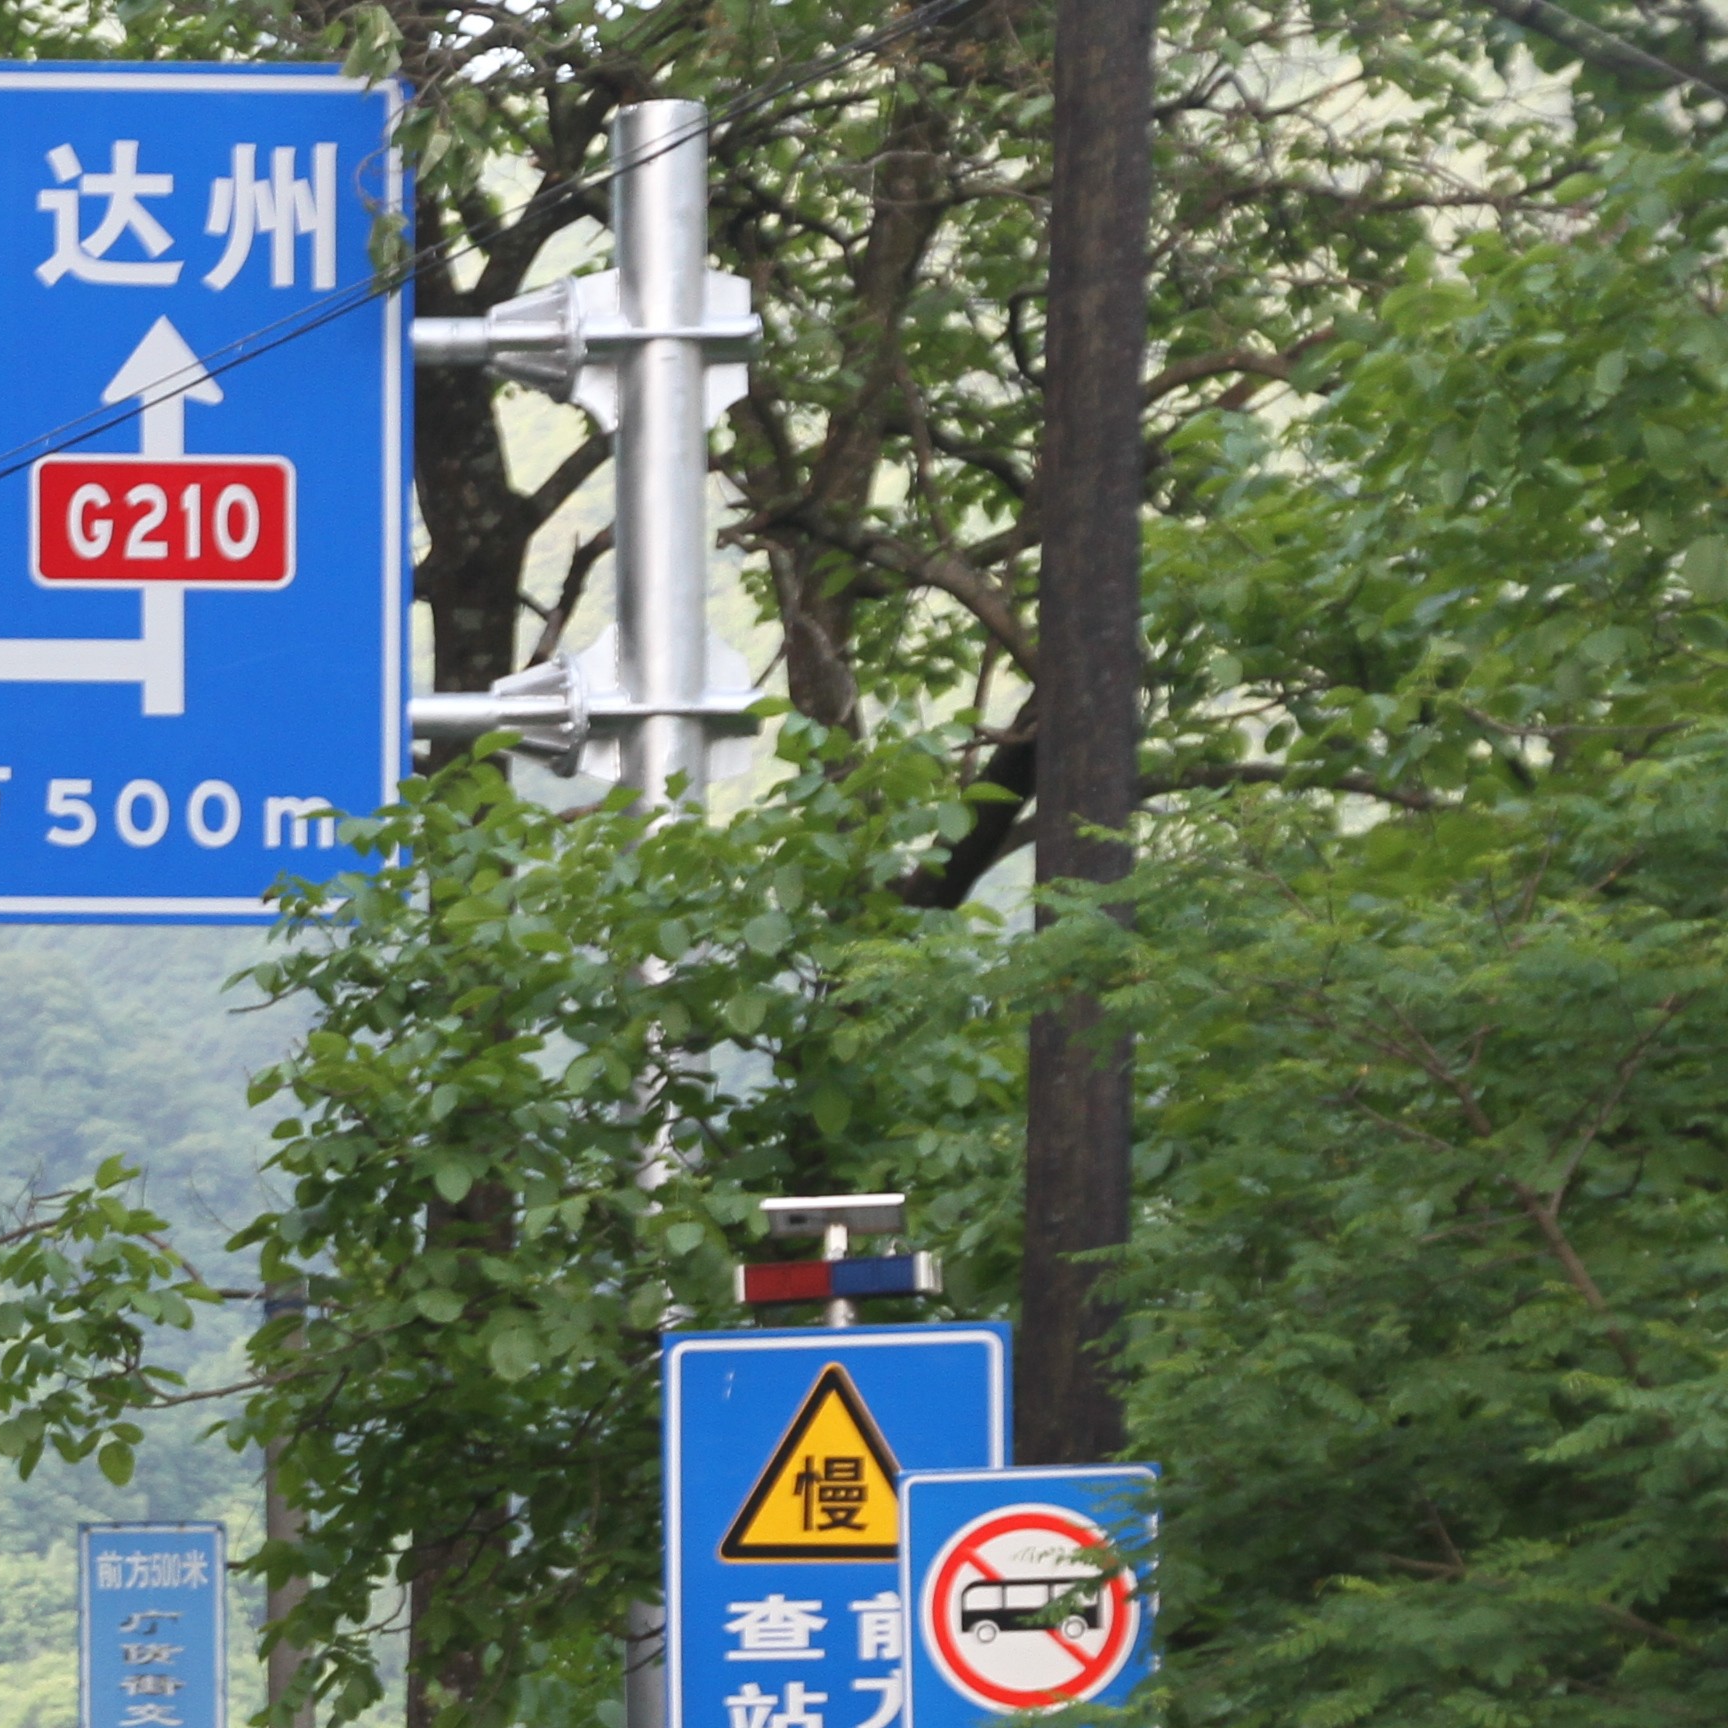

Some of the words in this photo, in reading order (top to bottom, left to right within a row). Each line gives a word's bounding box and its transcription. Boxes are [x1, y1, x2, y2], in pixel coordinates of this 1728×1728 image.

[36, 140, 338, 291] 达州
[66, 484, 260, 561] G210
[793, 1455, 870, 1531] 慢
[96, 1550, 208, 1590] 前方500米
